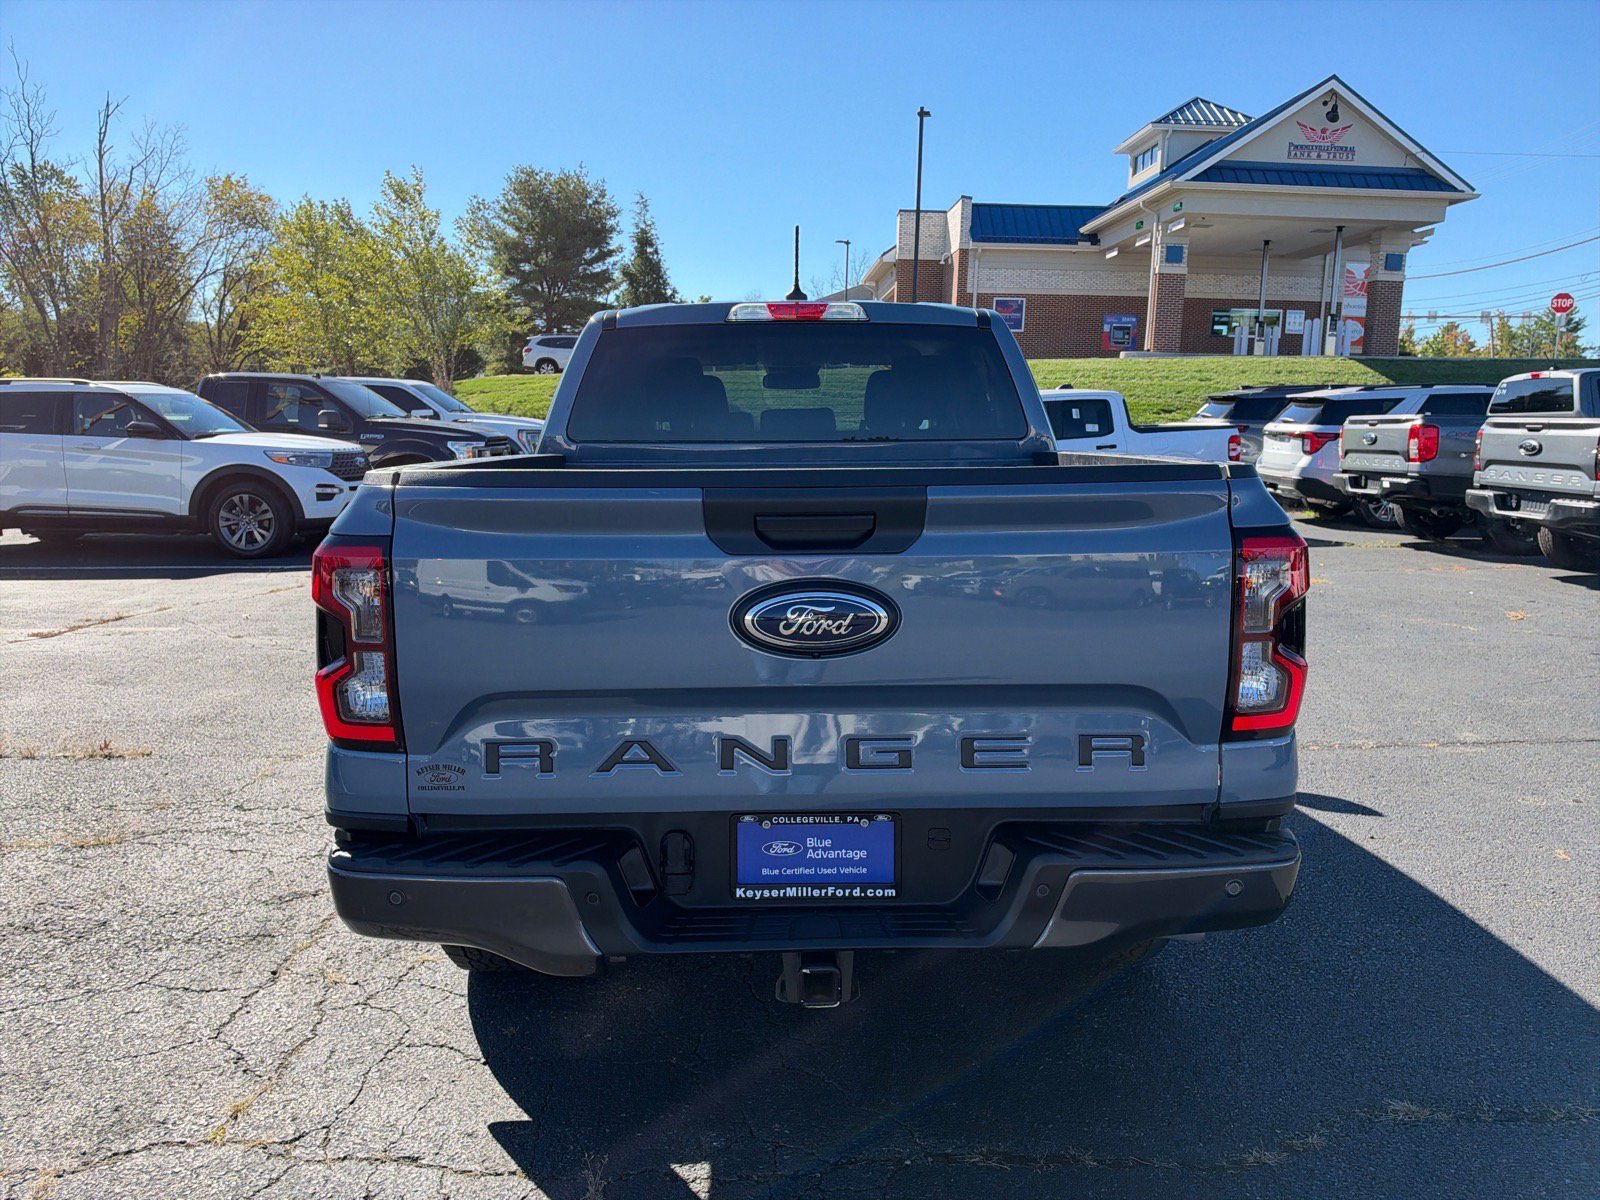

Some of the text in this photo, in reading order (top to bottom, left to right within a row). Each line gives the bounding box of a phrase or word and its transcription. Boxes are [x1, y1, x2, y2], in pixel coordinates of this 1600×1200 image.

[1327, 152, 1355, 160] TRUST
[1551, 298, 1574, 308] STOP
[1486, 468, 1583, 488] RANGER
[778, 604, 855, 636] Ford
[481, 733, 1149, 781] RANGER
[416, 764, 466, 776] KEYSER MILLER
[429, 772, 453, 783] Ford
[772, 816, 844, 825] COLLEGEVILLE,
[806, 837, 832, 848] Blue
[769, 843, 795, 854] Ford
[806, 848, 868, 860] Advantage
[761, 866, 868, 876] Blue Certified Used Vehicle
[735, 886, 896, 900] KeyserMillerFord.com
